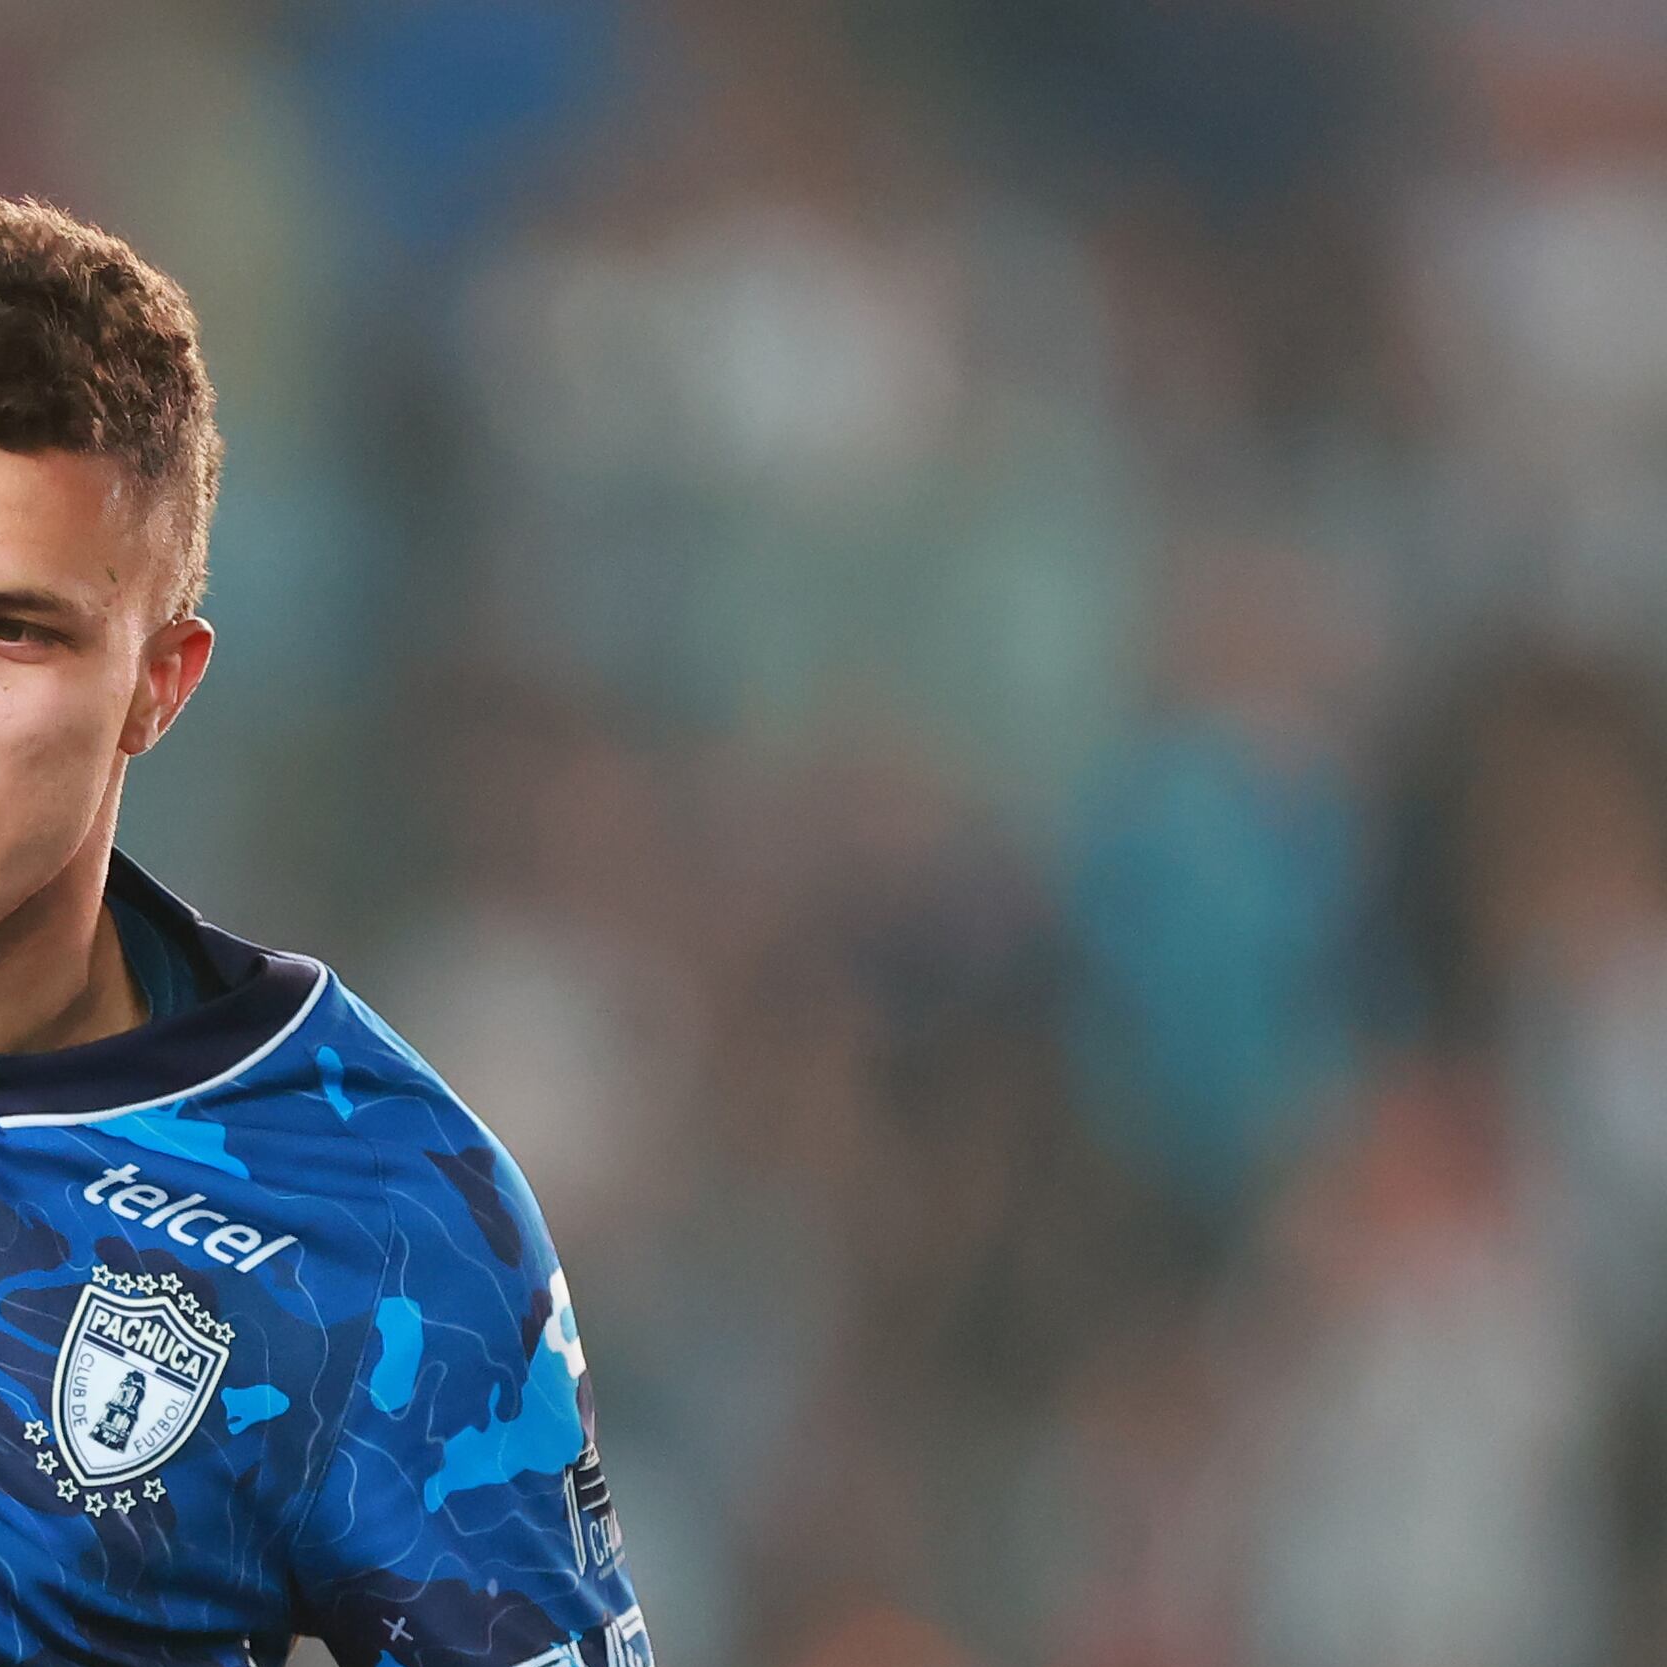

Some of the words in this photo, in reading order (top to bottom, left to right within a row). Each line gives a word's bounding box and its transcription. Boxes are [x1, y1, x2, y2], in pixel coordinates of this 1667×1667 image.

[82, 1162, 299, 1275] telcel
[90, 1308, 202, 1381] PACHUCA
[72, 1353, 95, 1398] CLUB
[71, 1404, 88, 1428] DE
[133, 1397, 186, 1455] FUTBOL
